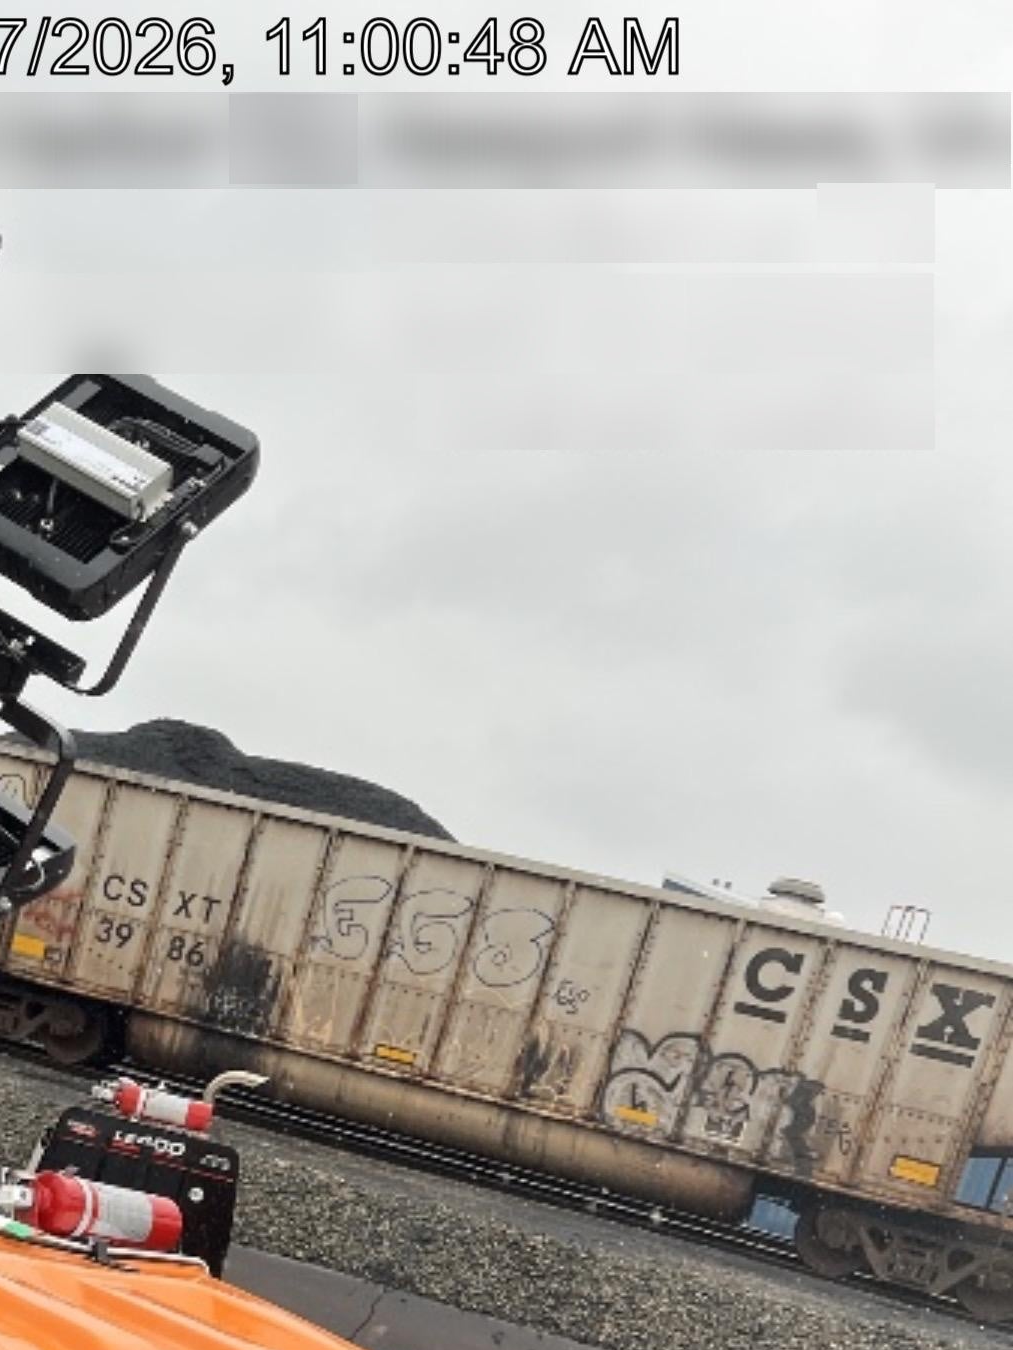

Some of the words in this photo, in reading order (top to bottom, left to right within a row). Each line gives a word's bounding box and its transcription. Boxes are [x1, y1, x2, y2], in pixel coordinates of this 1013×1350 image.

[103, 875, 148, 907] CS
[173, 890, 221, 924] XT
[94, 918, 133, 948] 39
[166, 935, 205, 967] 86
[745, 947, 996, 1050] CSX
